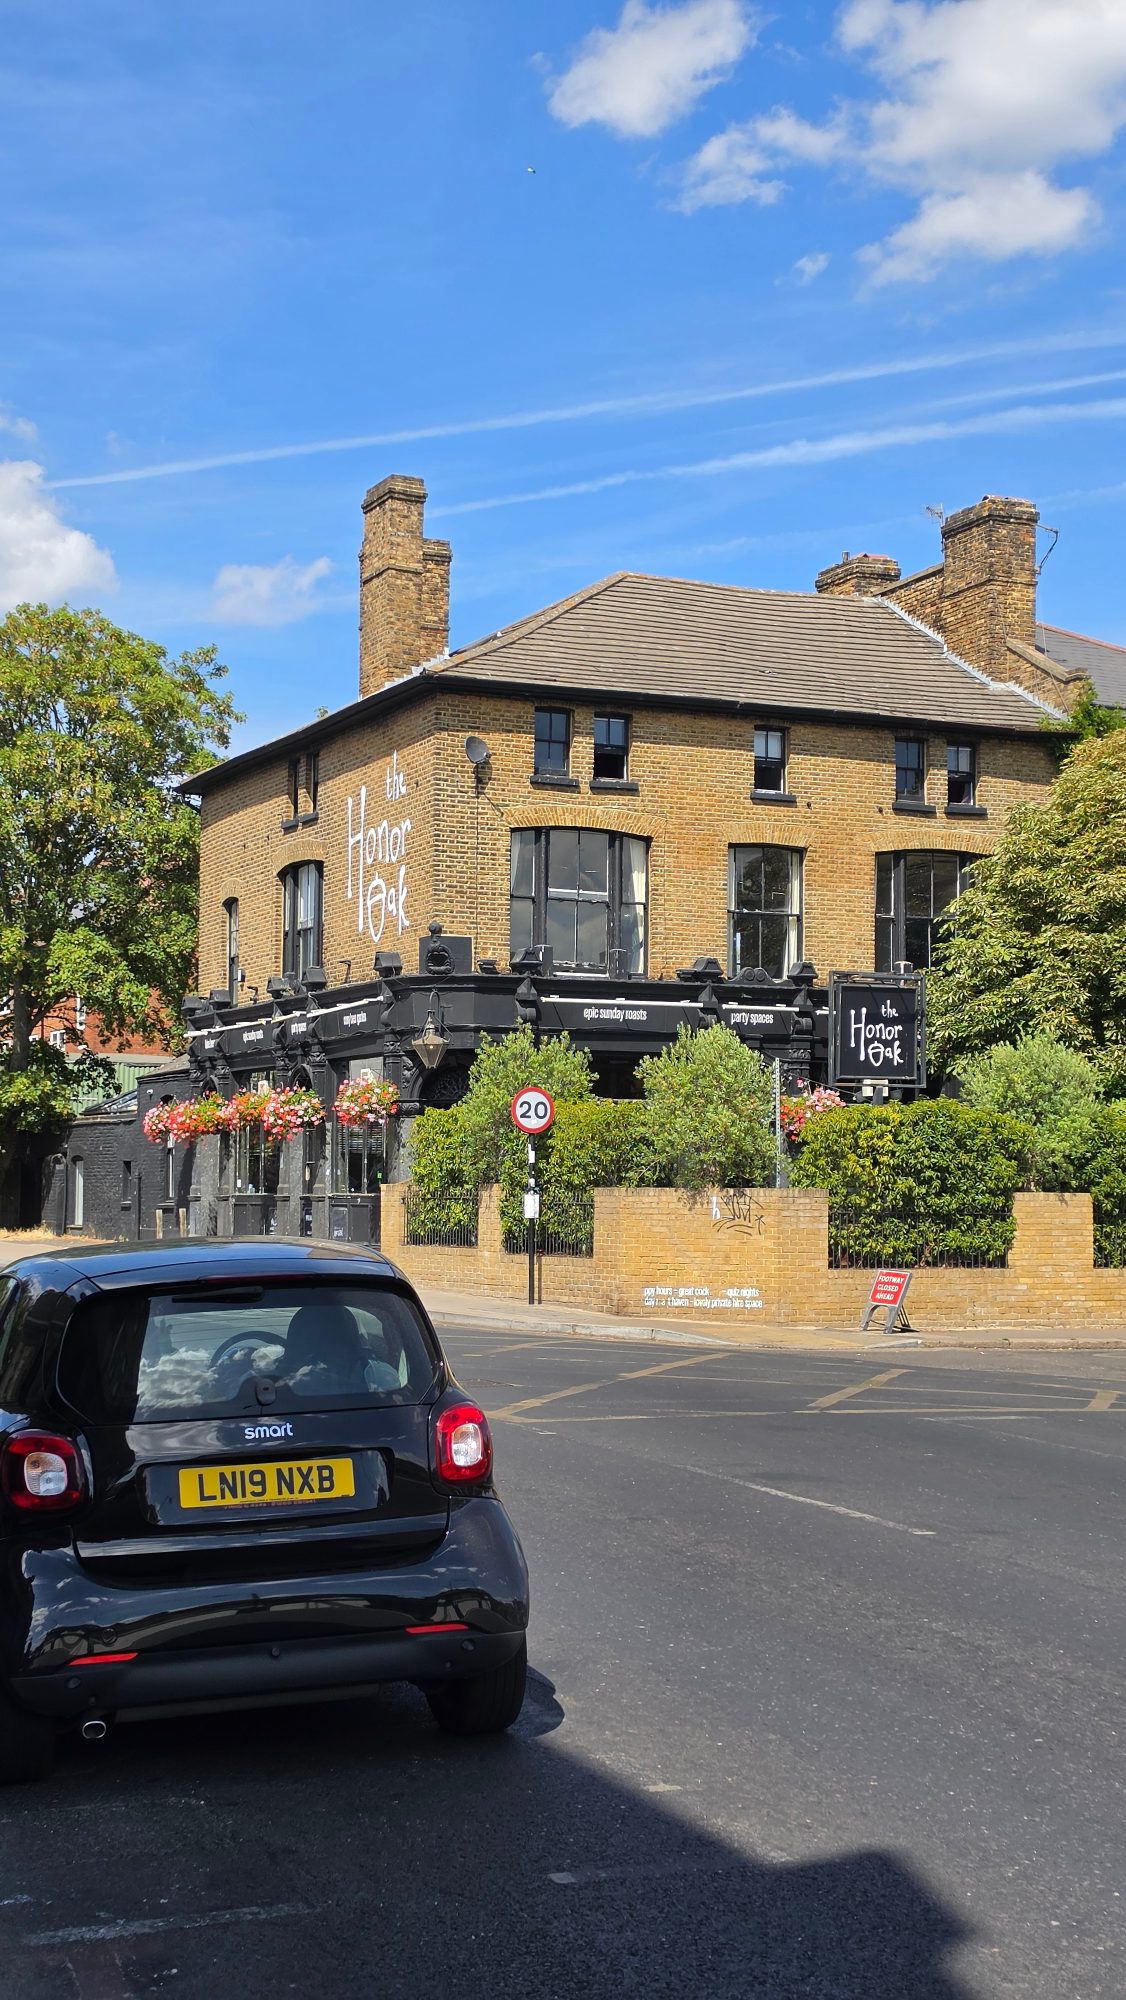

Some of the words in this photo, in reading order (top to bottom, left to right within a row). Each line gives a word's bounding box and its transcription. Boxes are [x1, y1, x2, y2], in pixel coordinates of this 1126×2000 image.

[386, 749, 407, 801] the
[347, 785, 412, 932] Honor
[367, 864, 410, 942] Oak
[583, 1007, 599, 1020] epic
[600, 1007, 625, 1022] sunday
[625, 1009, 647, 1021] roasts
[881, 1000, 899, 1018] the
[731, 1012, 749, 1025] party
[750, 1013, 773, 1025] spaces
[850, 1007, 903, 1061] Honor
[868, 1041, 904, 1067] Oak
[519, 1101, 548, 1119] 20
[877, 1284, 899, 1292] CLOSED
[879, 1275, 905, 1284] FOOTWAY
[876, 1292, 895, 1300] AHEAD
[244, 1422, 294, 1440] smart
[198, 1469, 267, 1501] LN19
[276, 1465, 335, 1496] NXB
